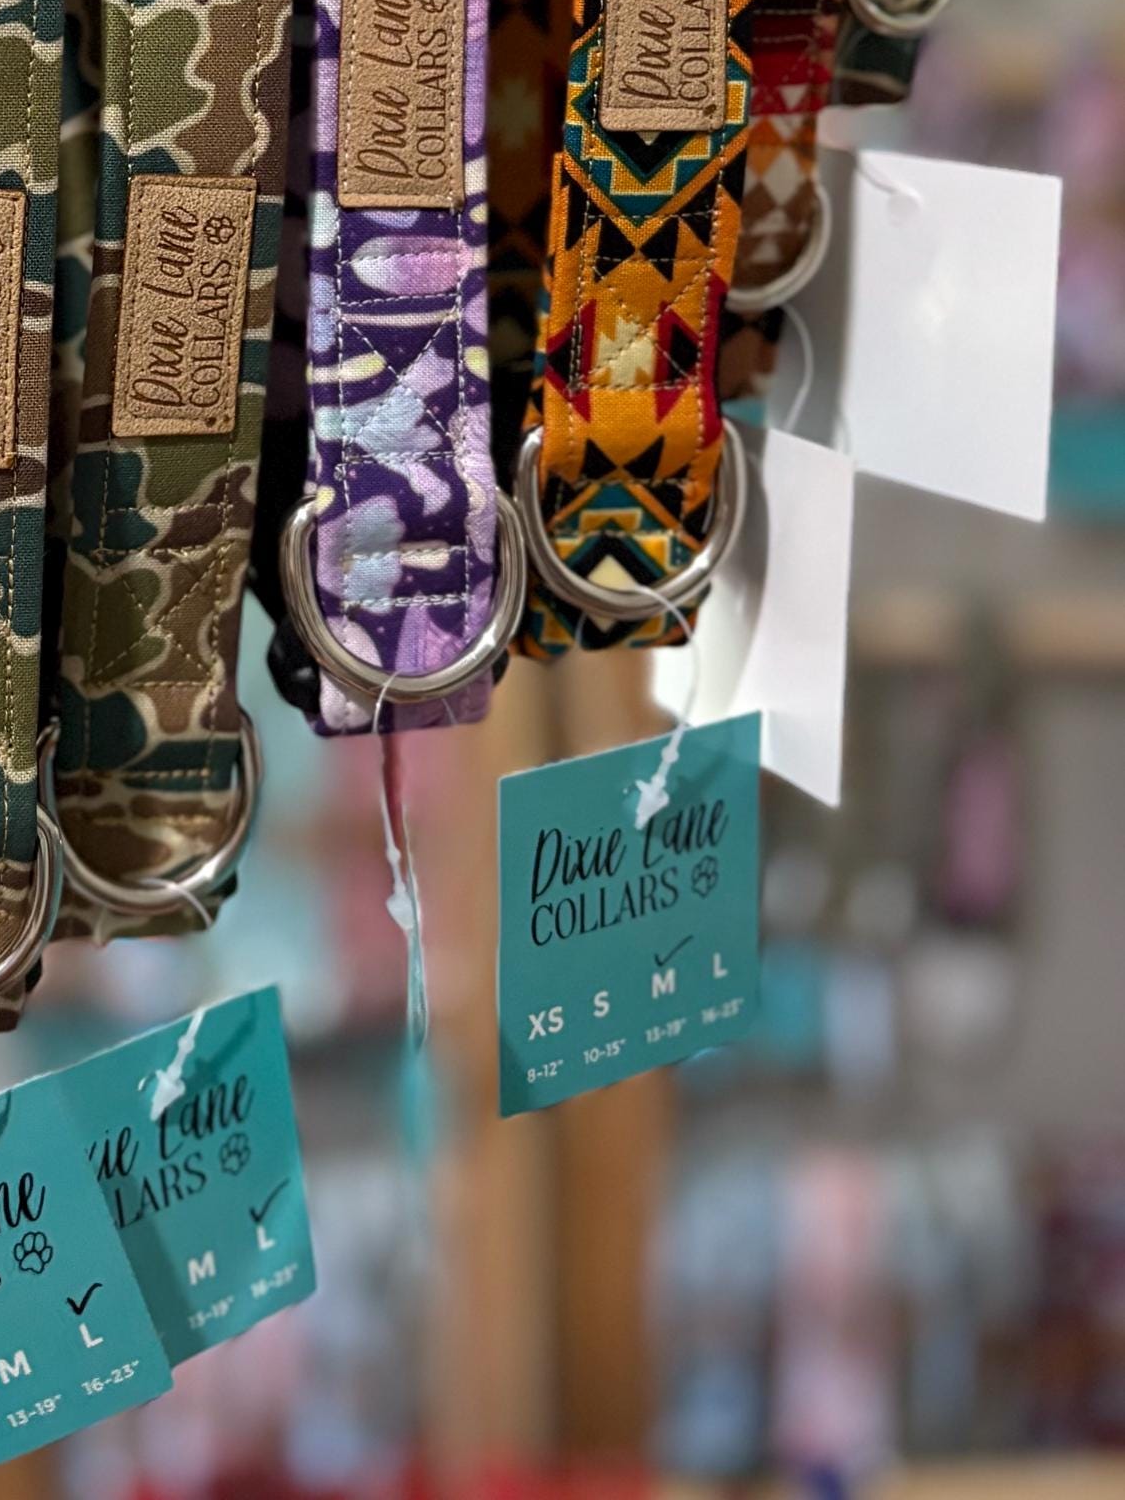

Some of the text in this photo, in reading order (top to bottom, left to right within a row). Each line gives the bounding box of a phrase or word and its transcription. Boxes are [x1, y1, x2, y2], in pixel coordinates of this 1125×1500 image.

[619, 5, 676, 100] Dixie
[354, 85, 413, 179] Dixie
[416, 28, 448, 180] COLLARS
[129, 205, 199, 407] Dixie Lane
[189, 258, 233, 408] COLLARS
[531, 799, 729, 904] Dixie Lane
[531, 867, 679, 946] COLLARS
[527, 953, 728, 1041] XS S M L
[159, 1074, 255, 1162] Lane
[113, 1152, 208, 1230] LARS
[187, 1225, 275, 1285] M L
[78, 1323, 104, 1349] L
